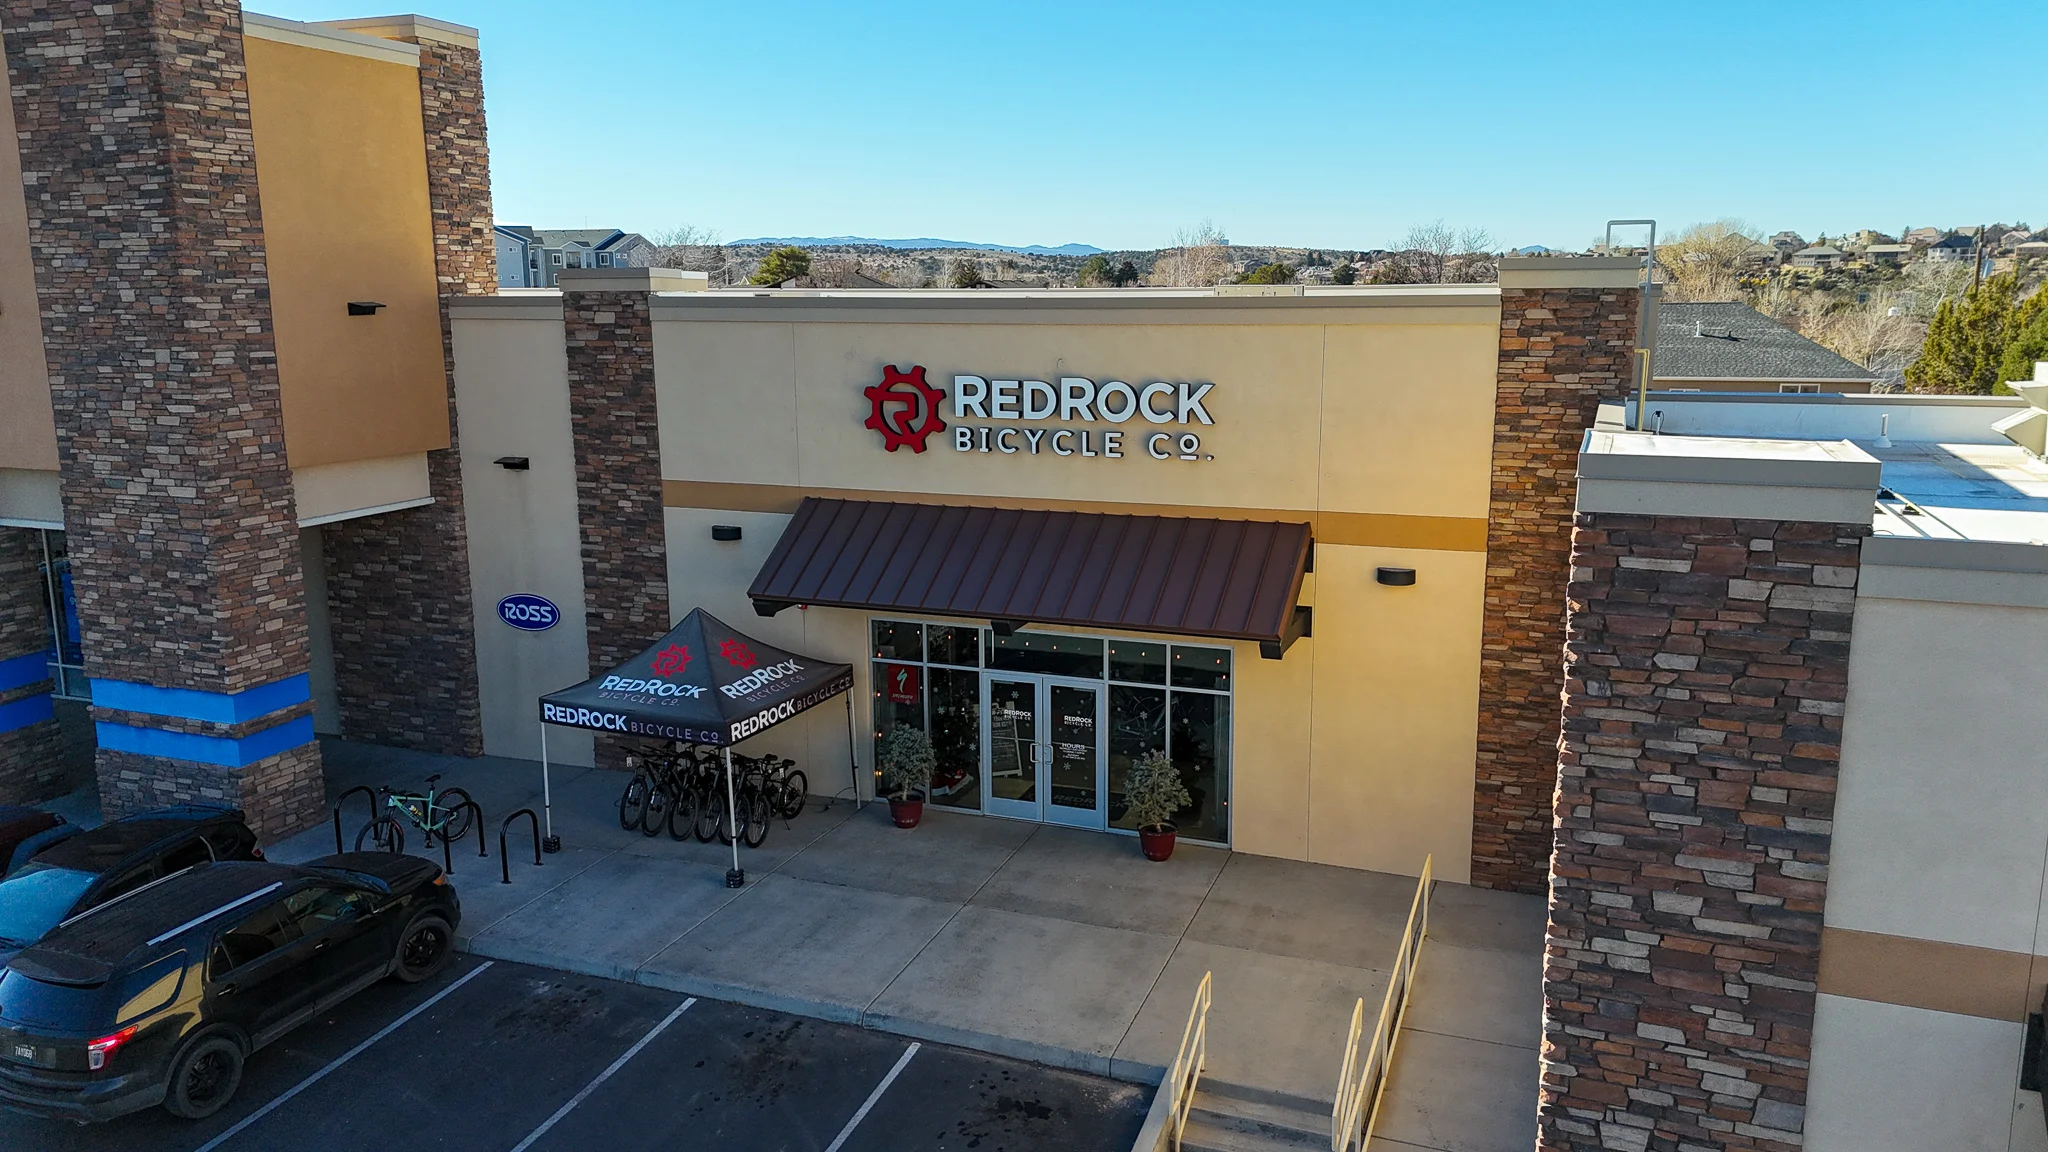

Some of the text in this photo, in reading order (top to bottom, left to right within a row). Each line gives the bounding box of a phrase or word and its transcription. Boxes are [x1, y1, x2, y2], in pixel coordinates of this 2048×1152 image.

[954, 375, 1215, 425] REDROCK
[954, 426, 1124, 458] BICYCLE
[504, 602, 553, 623] ROSS
[598, 675, 708, 699] REDROCK
[720, 658, 805, 699] REDROCK
[598, 691, 657, 705] BICYCLE
[745, 680, 789, 703] BICYCLE
[543, 703, 628, 732] REDROCK
[630, 721, 692, 740] BICYCLE
[730, 698, 796, 742] REDROCK
[796, 683, 836, 711] BICYCLE
[1003, 709, 1032, 718] REDROCK
[1064, 715, 1093, 724] REDROCK
